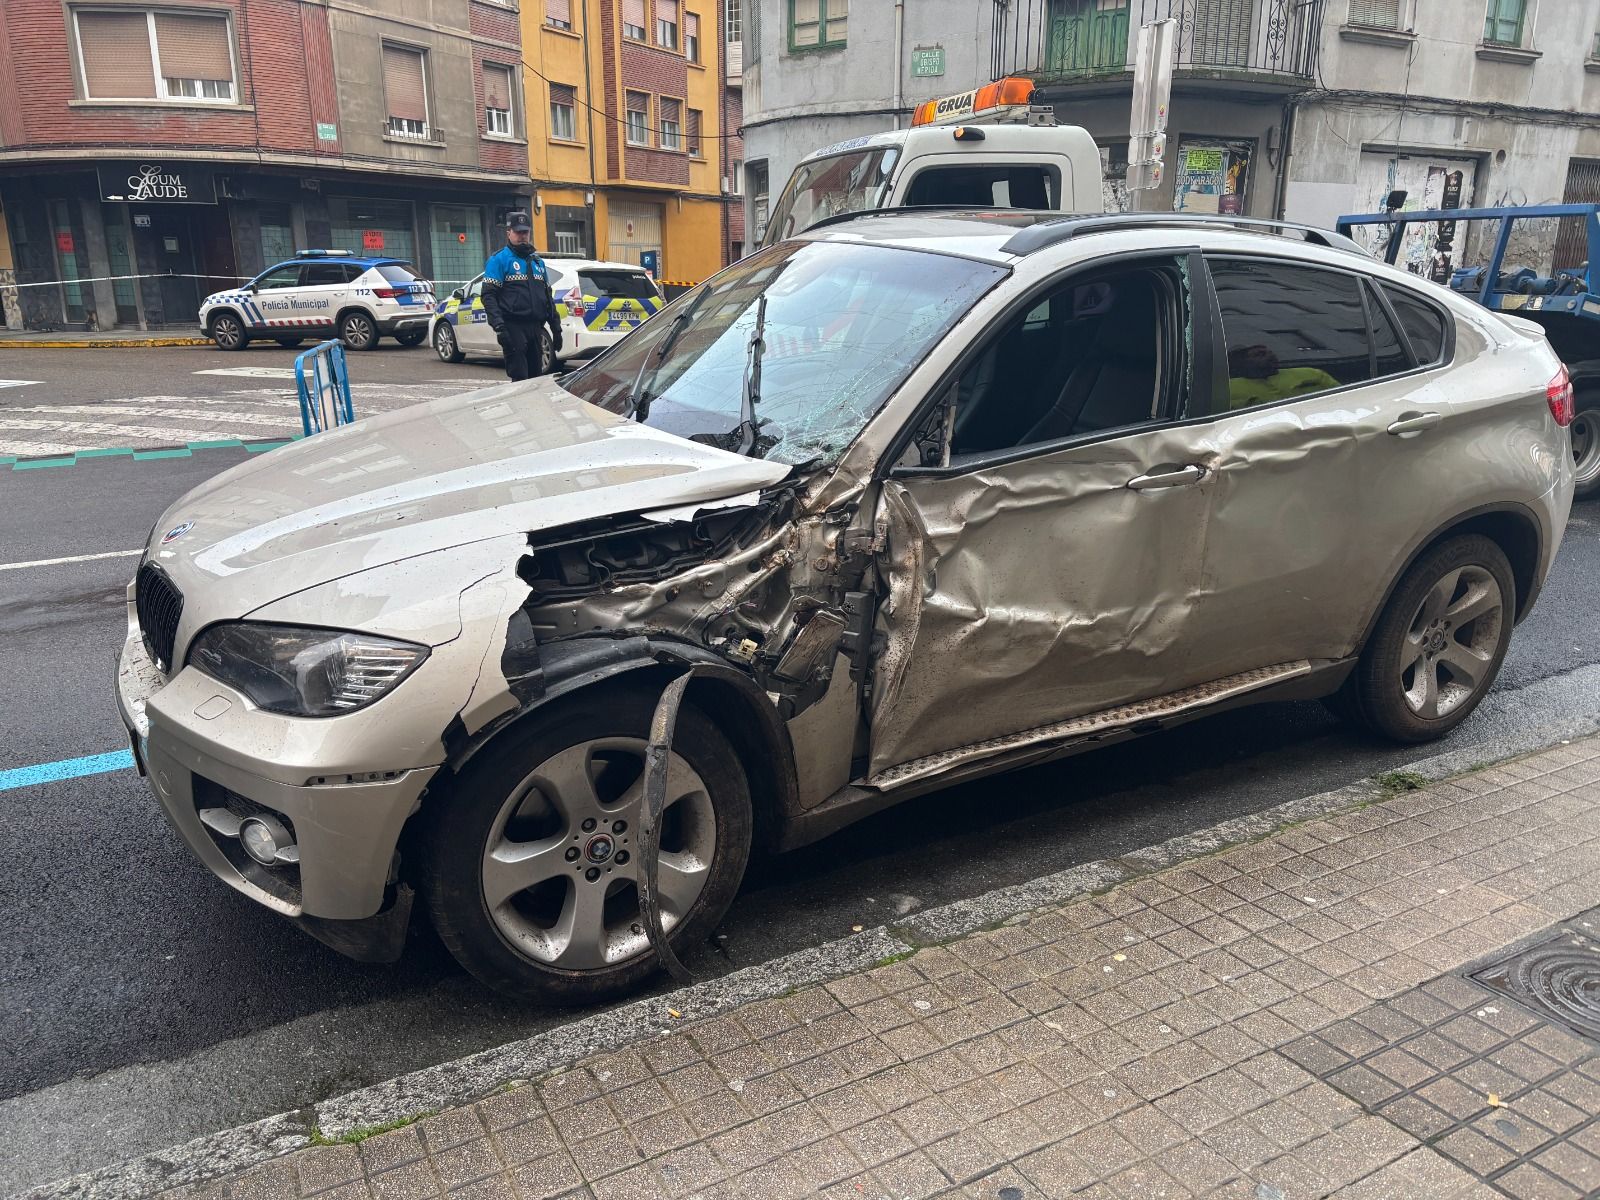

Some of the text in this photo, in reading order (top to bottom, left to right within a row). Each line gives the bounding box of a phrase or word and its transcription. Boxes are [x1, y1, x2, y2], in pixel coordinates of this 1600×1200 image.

[937, 94, 972, 113] GRUA
[291, 299, 329, 310] Municipal
[463, 313, 488, 322] POLIC
